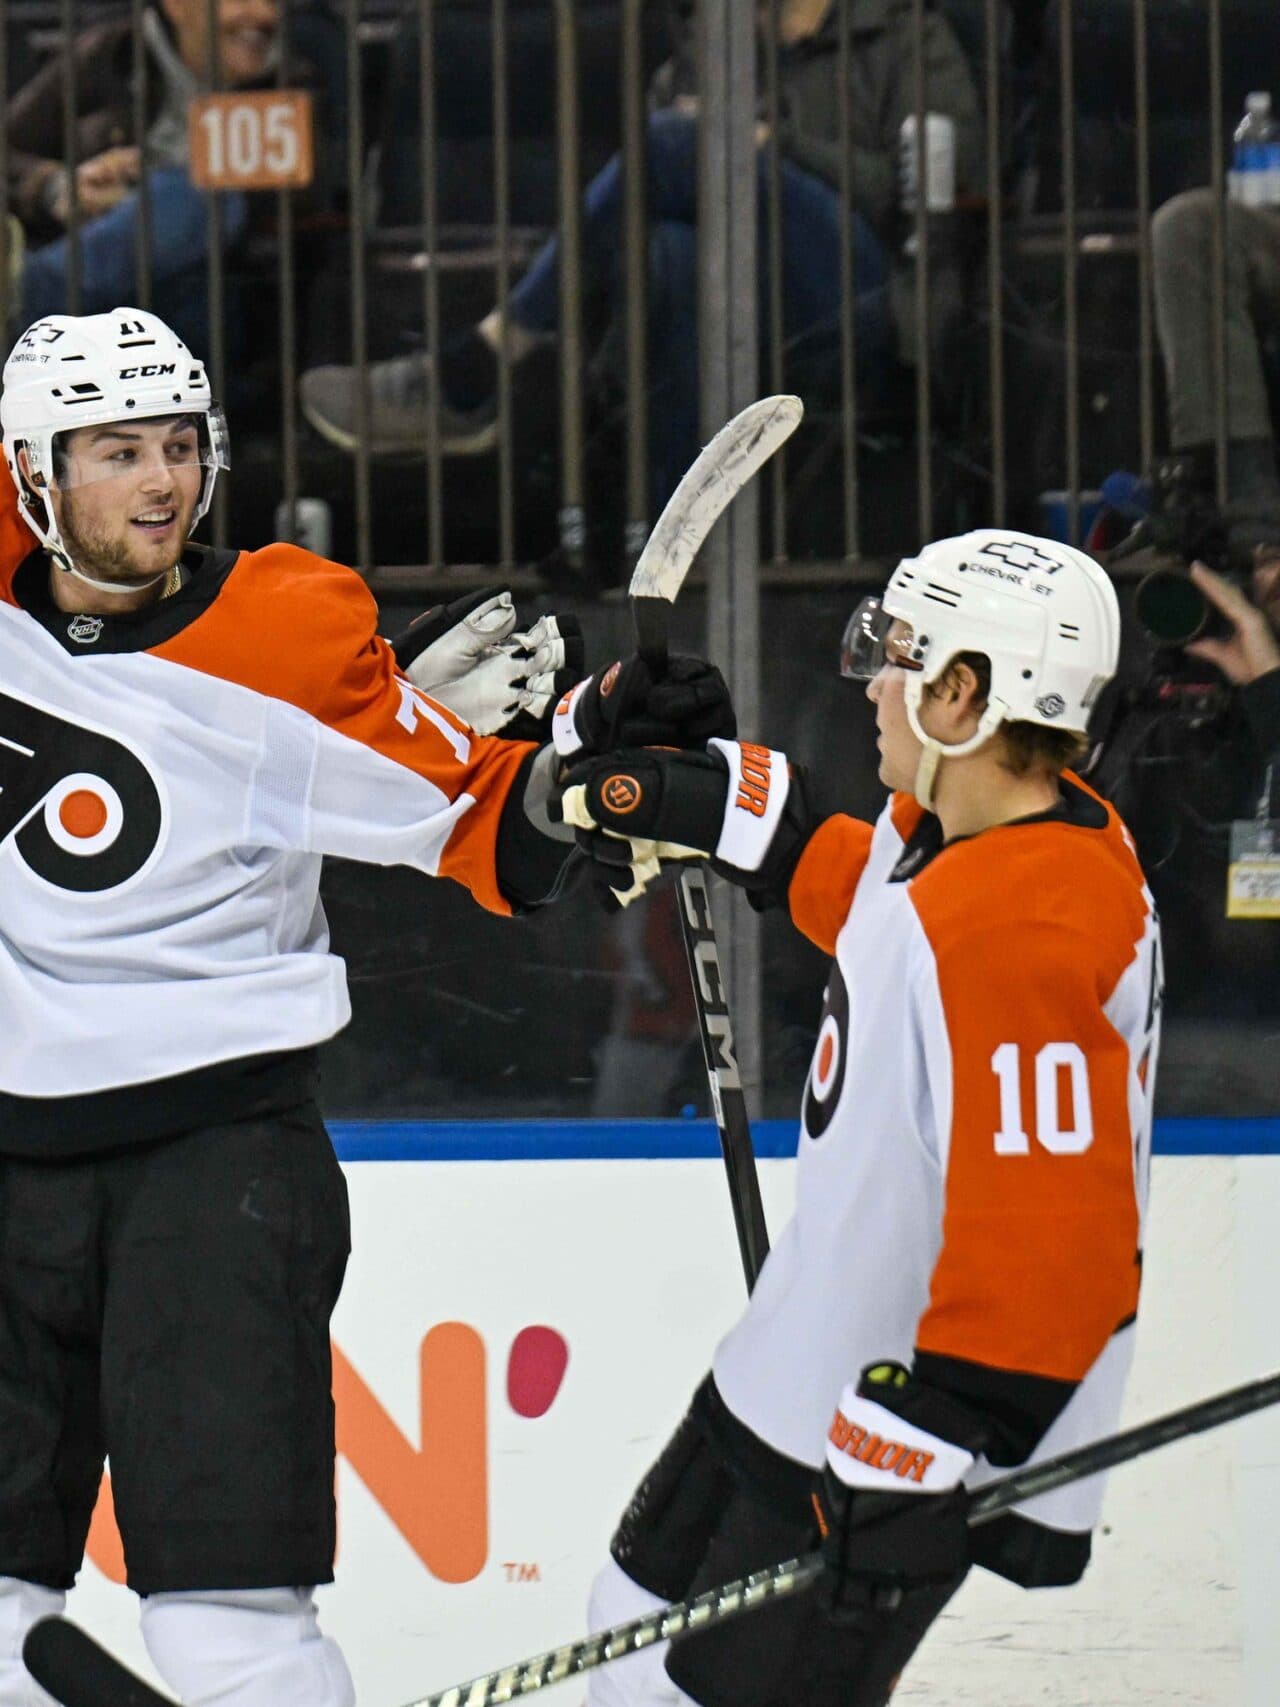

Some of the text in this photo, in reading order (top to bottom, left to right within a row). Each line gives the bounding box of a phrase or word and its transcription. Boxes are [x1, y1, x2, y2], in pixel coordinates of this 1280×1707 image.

[201, 105, 297, 176] 105
[119, 363, 176, 380] CCM
[680, 866, 743, 1089] CCM
[991, 1042, 1094, 1157] 10
[503, 1562, 542, 1583] TM
